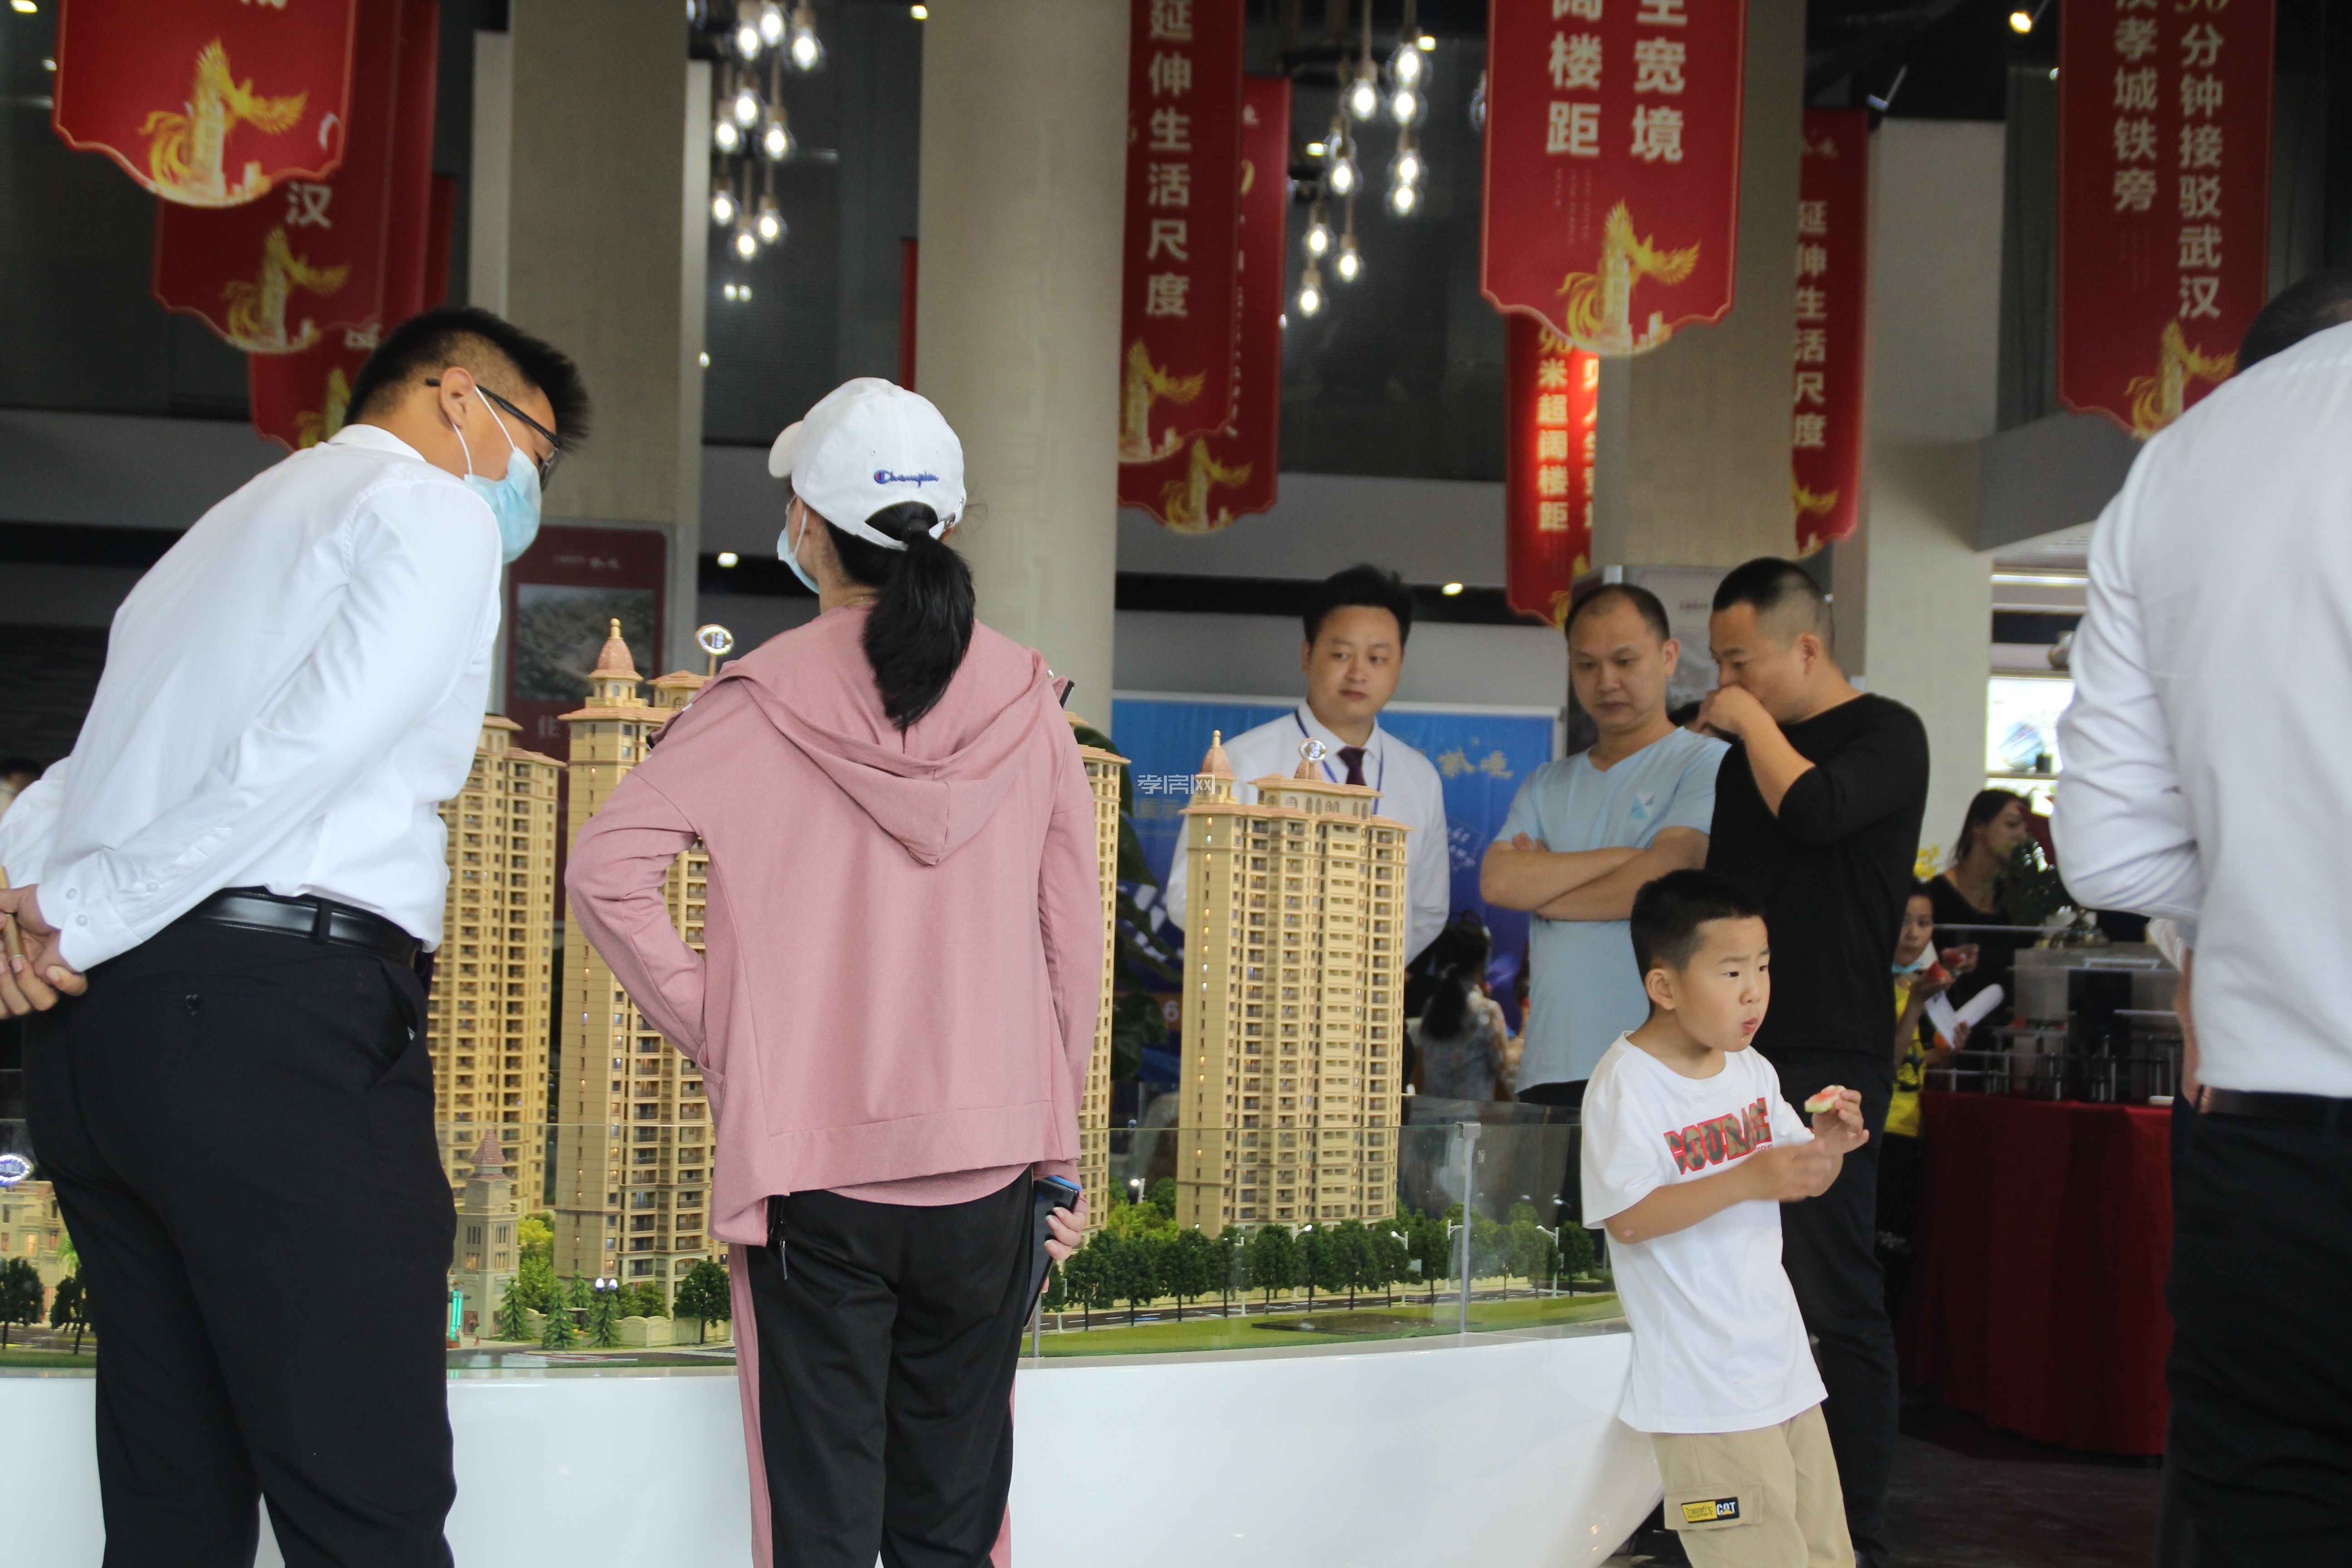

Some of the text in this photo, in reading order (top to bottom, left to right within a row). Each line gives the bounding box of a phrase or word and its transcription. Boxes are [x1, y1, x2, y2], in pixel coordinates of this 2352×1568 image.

[286, 182, 332, 228] 汉
[1146, 0, 1192, 318] 延伸生活尺度
[2112, 0, 2158, 213] 孝城铁旁
[2174, 0, 2227, 319] 分钟接驳武汉
[1716, 1502, 1735, 1515] CAT
